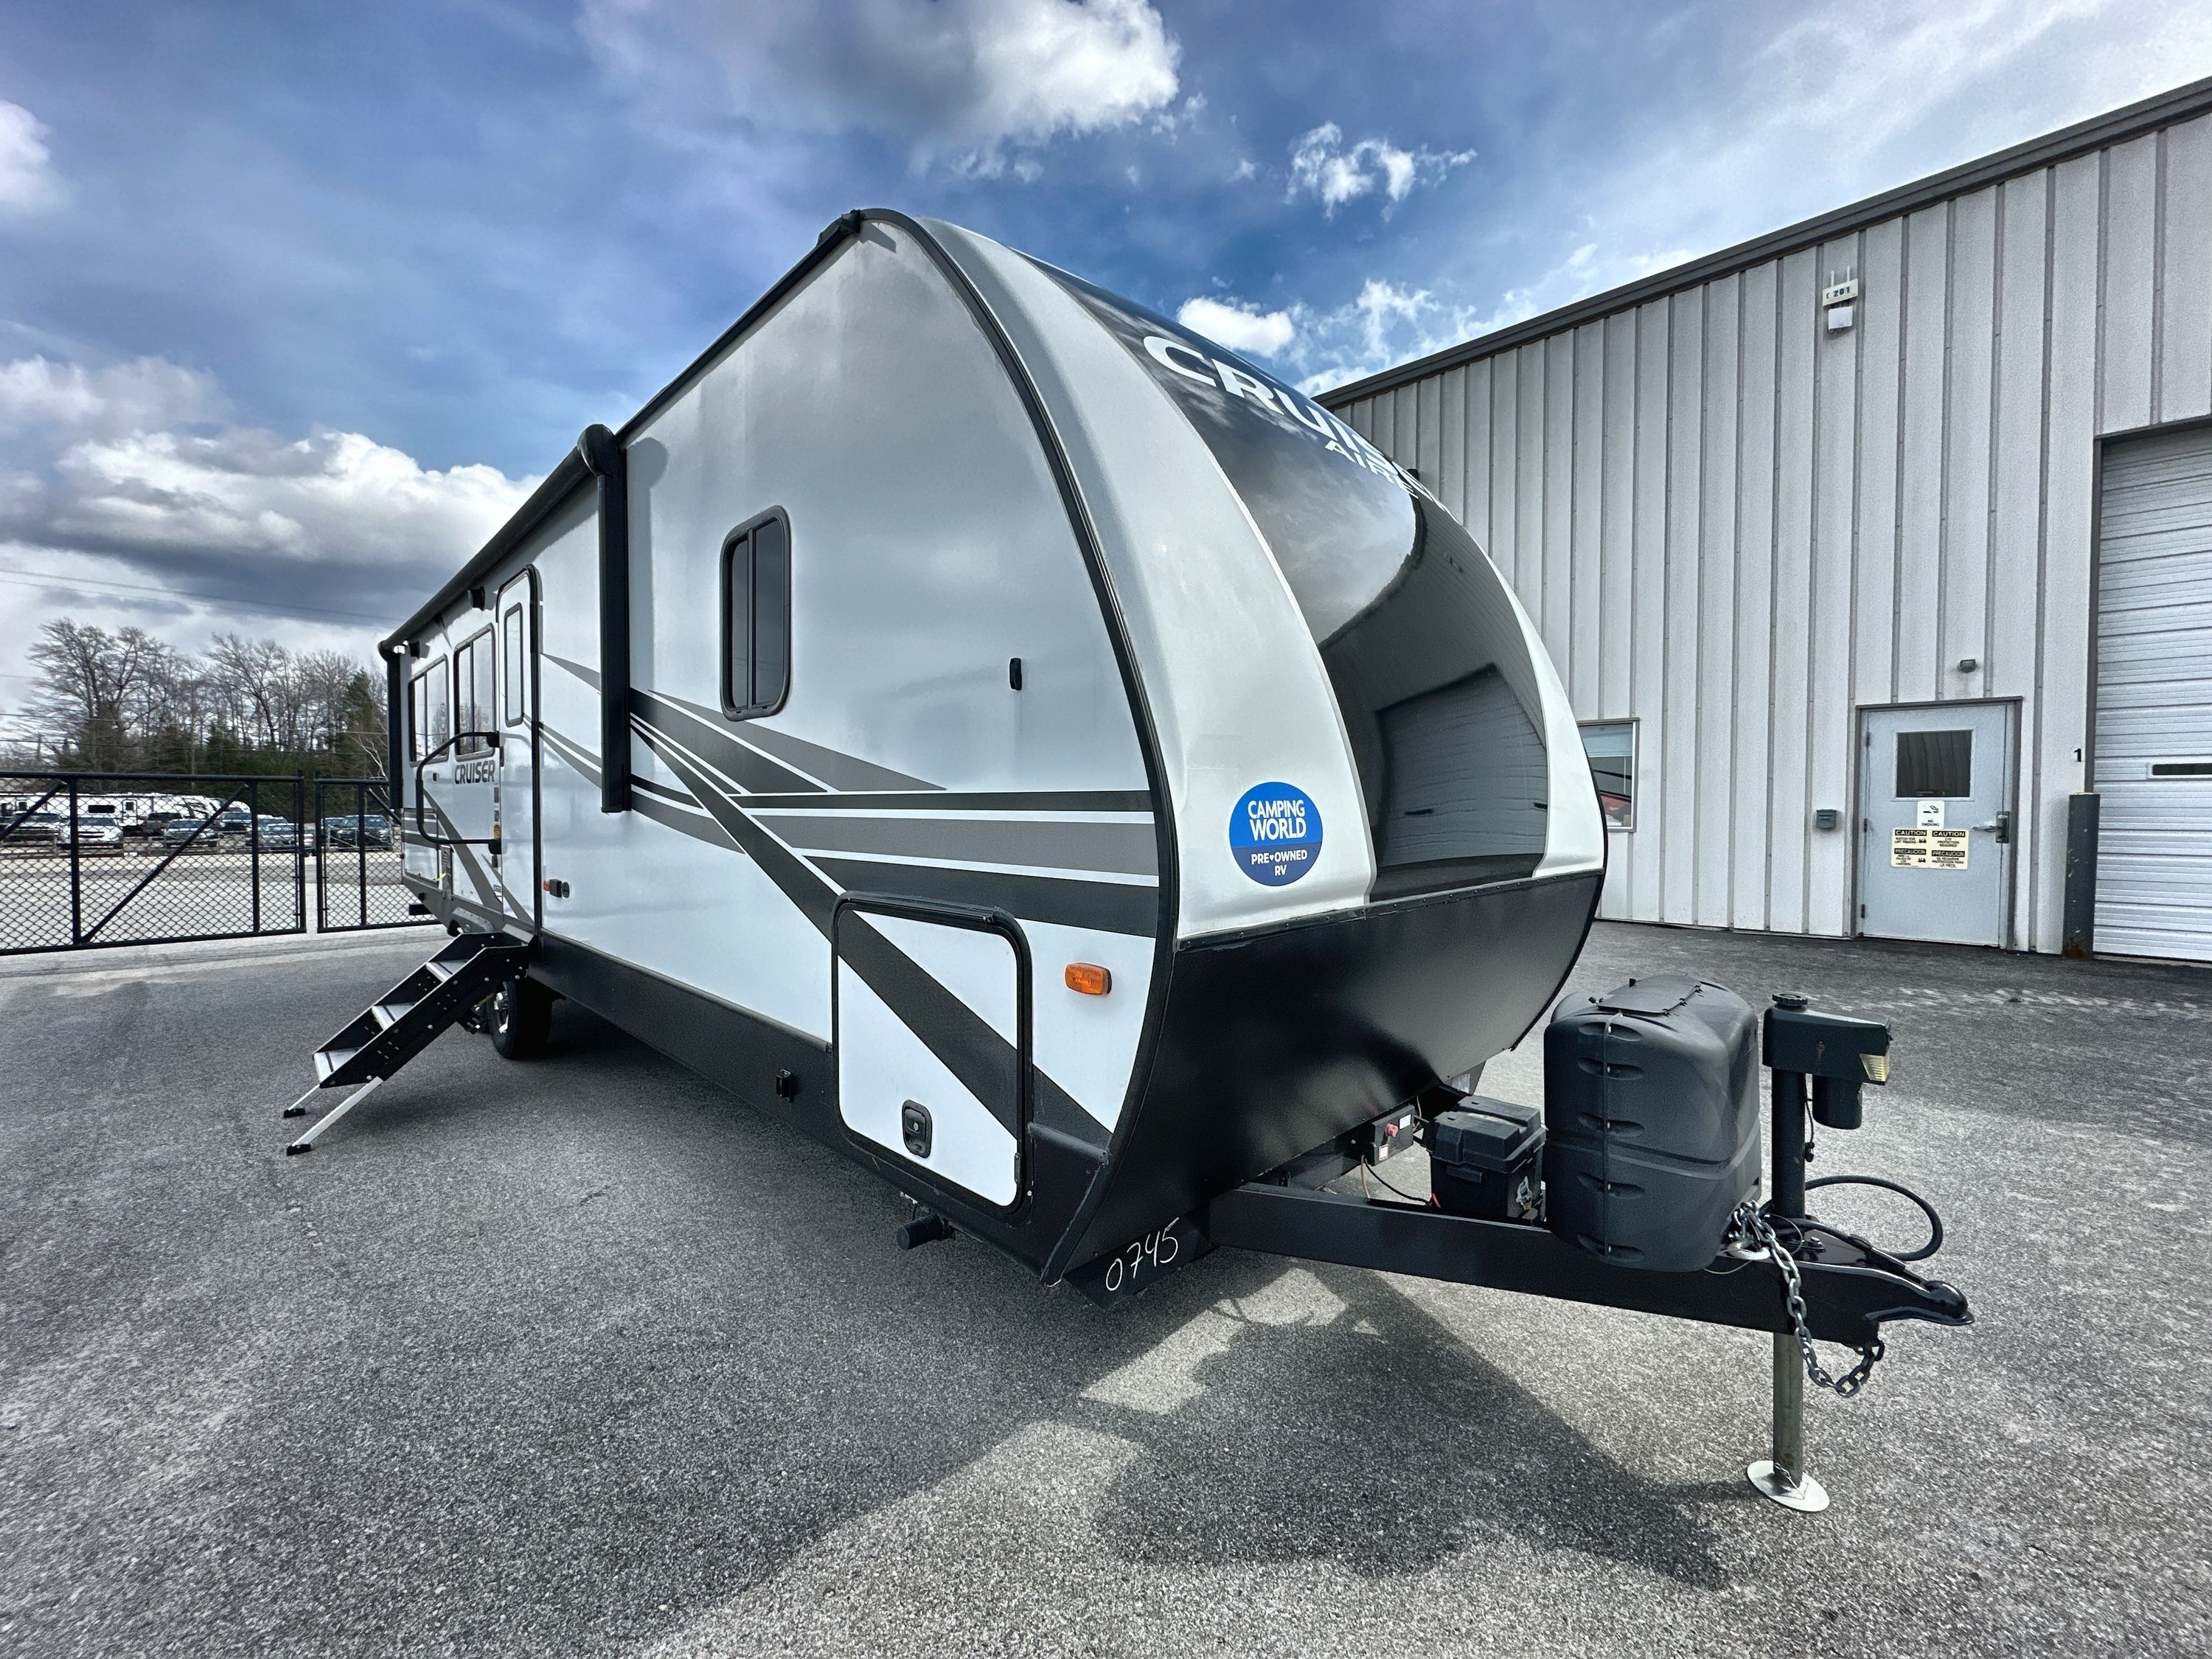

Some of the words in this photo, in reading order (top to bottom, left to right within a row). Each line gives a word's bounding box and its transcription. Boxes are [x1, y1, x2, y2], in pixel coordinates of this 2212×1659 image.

[1834, 286, 1851, 297] 201
[1324, 439, 1419, 500] AIRE
[2073, 748, 2082, 762] 1
[454, 759, 495, 784] CRUISER
[1248, 799, 1305, 819] CAMPING
[1249, 817, 1307, 841] WORLD
[1274, 864, 1287, 876] RV
[1106, 1217, 1180, 1291] 0745
